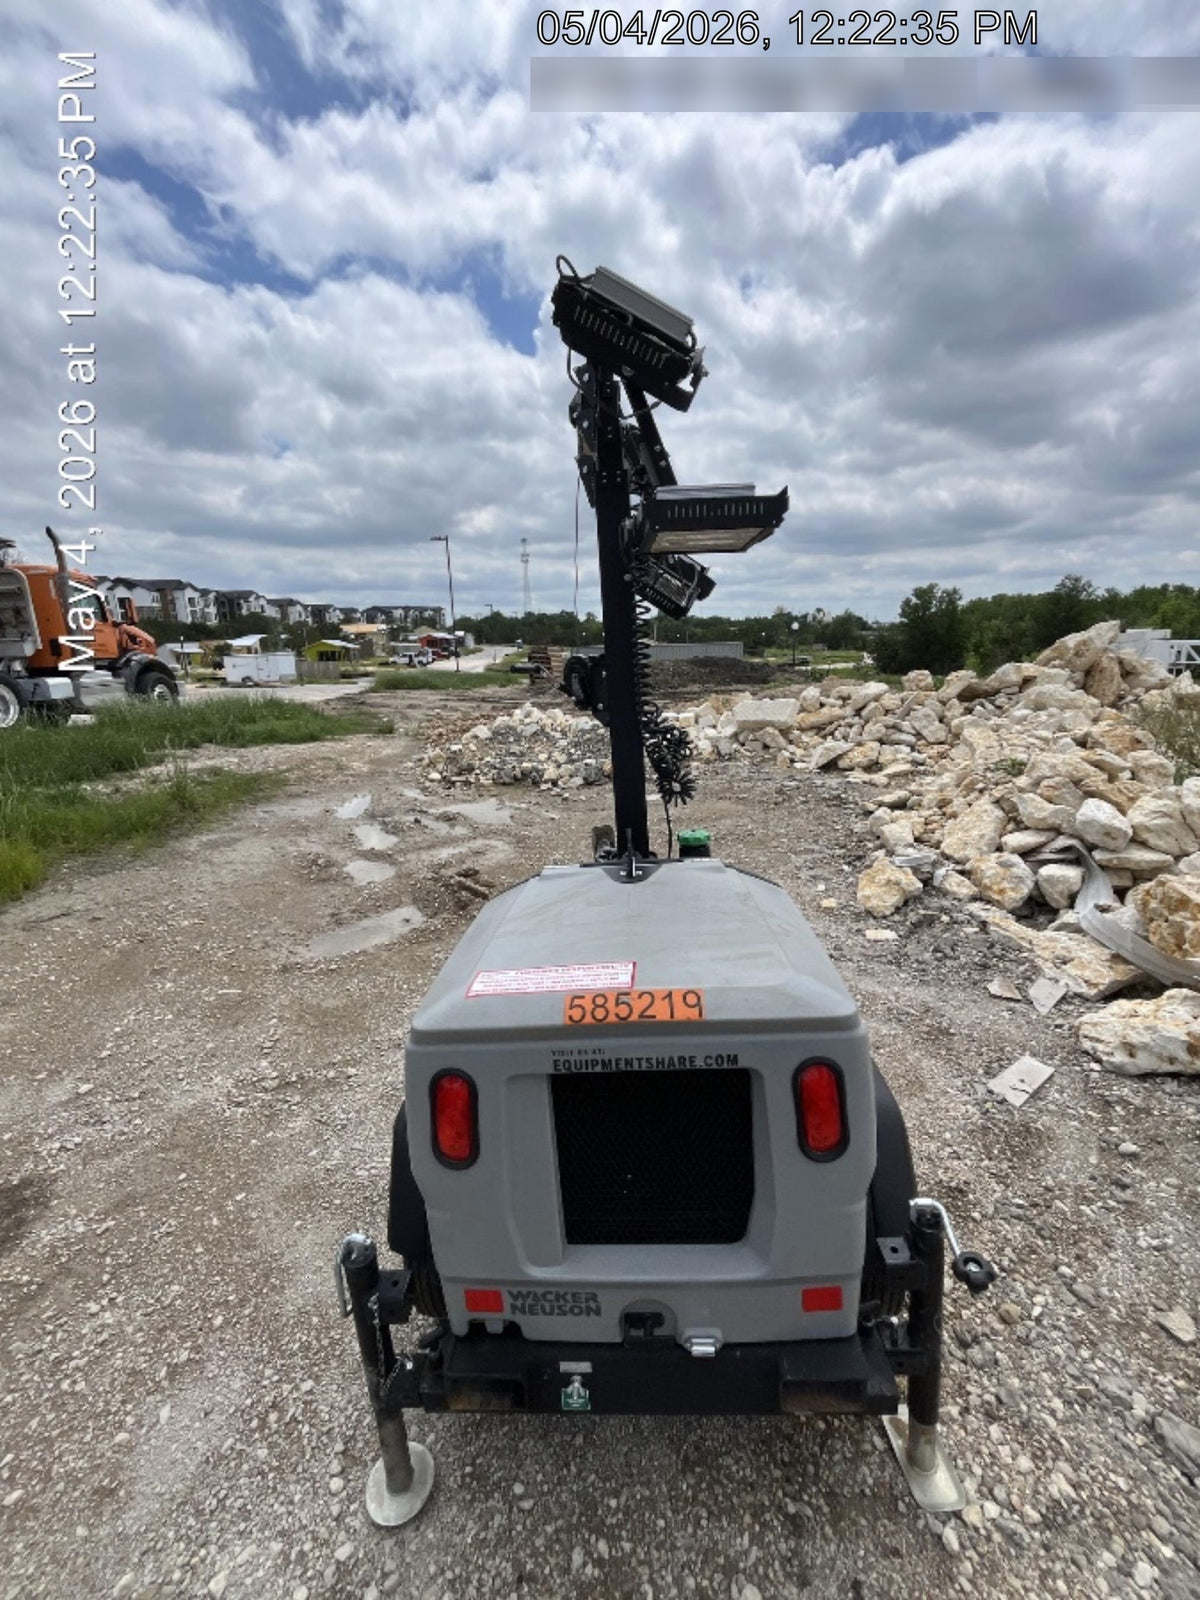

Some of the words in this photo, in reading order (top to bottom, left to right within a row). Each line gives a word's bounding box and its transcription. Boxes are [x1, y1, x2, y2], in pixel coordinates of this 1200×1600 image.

[567, 990, 703, 1023] 585219
[553, 1054, 739, 1073] EQUIPMENTSHARE.COM
[508, 1290, 598, 1304] WACKER
[510, 1302, 602, 1317] NEUSON
